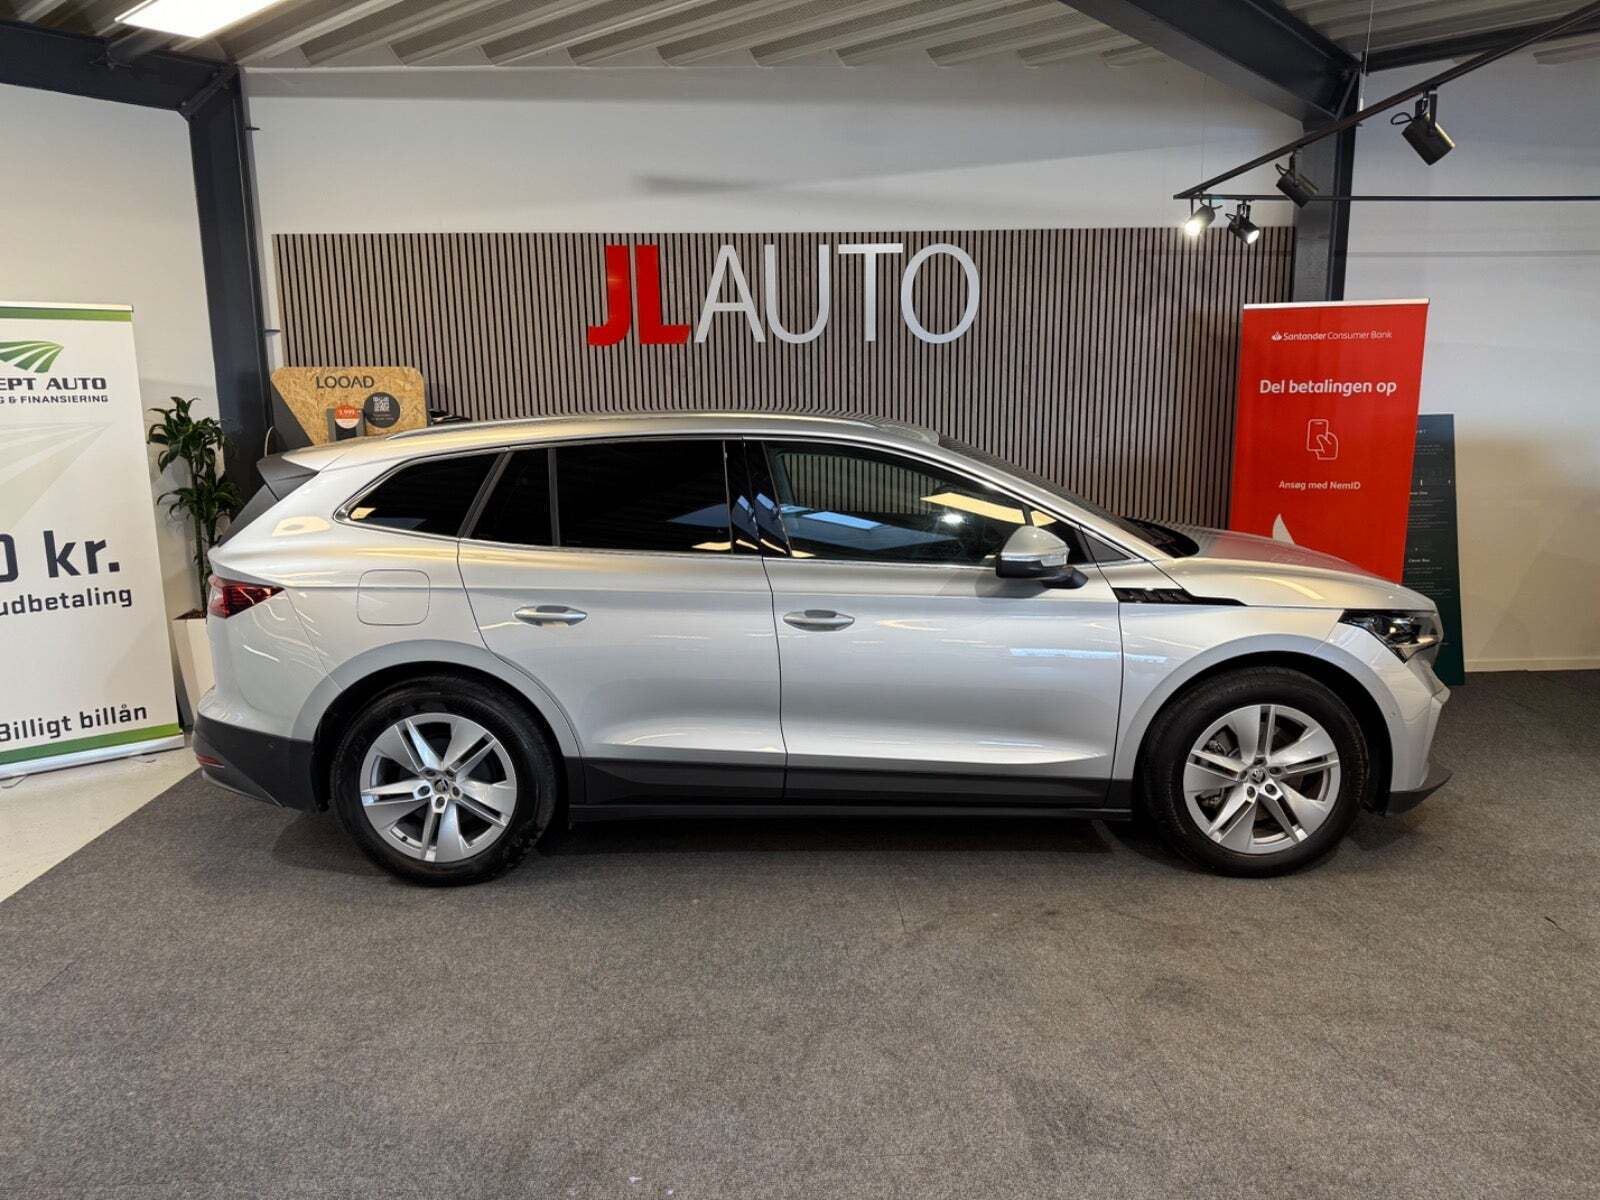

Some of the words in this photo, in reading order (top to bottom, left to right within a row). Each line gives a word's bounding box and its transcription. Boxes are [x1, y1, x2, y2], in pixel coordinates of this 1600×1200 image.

[1283, 331, 1327, 341] Santander
[1327, 331, 1370, 340] Consumer
[1371, 331, 1393, 339] Bank
[46, 377, 107, 390] AUTO
[316, 375, 375, 389] LOOAD
[1259, 380, 1285, 394] Del
[1289, 379, 1372, 397] betalingen
[1376, 382, 1397, 396] op
[20, 395, 109, 404] FINANSIERING
[1279, 480, 1306, 490] Ansøg
[1308, 480, 1328, 489] med
[1330, 480, 1361, 490] NemID
[43, 530, 120, 578] kr.
[0, 715, 72, 742] Billigt
[80, 704, 147, 729] billån
